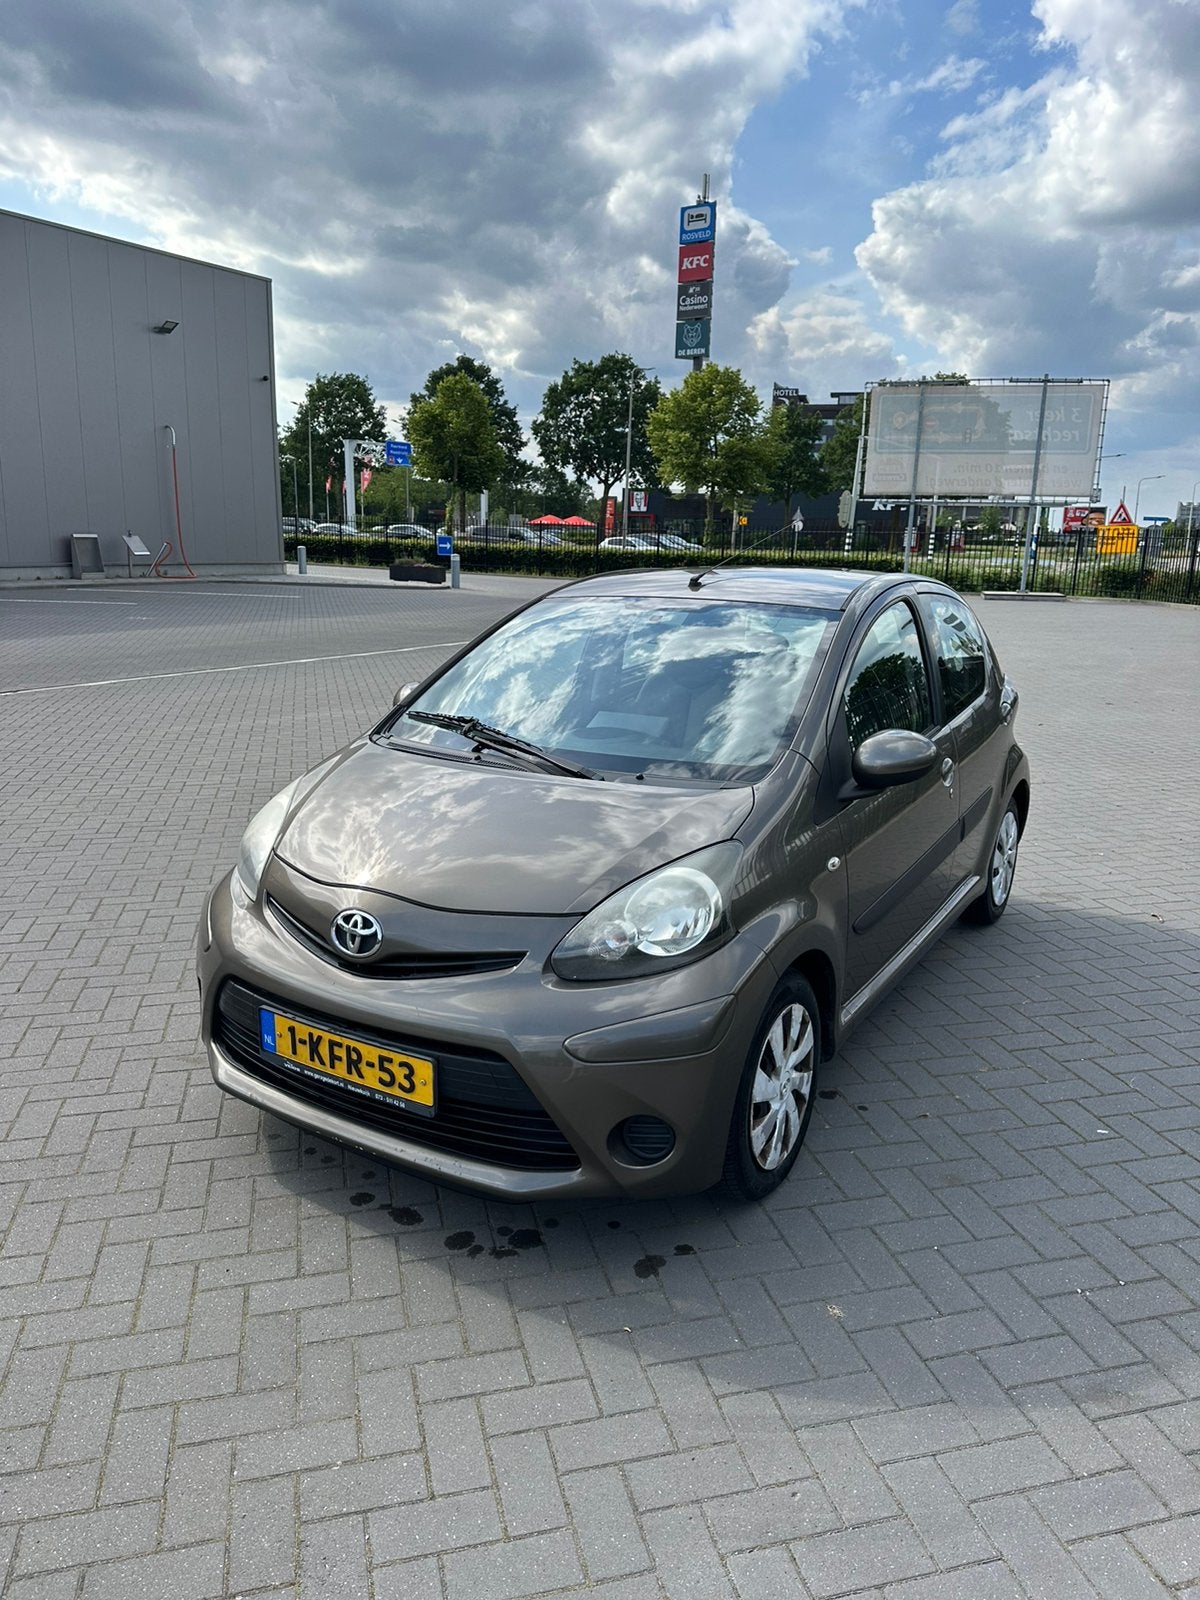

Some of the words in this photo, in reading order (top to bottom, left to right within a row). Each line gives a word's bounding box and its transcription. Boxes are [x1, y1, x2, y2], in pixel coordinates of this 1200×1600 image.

[682, 230, 711, 241] ROSVELD
[681, 254, 709, 270] KFC
[680, 294, 708, 306] Casino
[687, 347, 706, 356] BEREN
[774, 389, 798, 397] HOTEL
[264, 1034, 275, 1046] NL
[287, 1025, 416, 1094] 1-KFR-53
